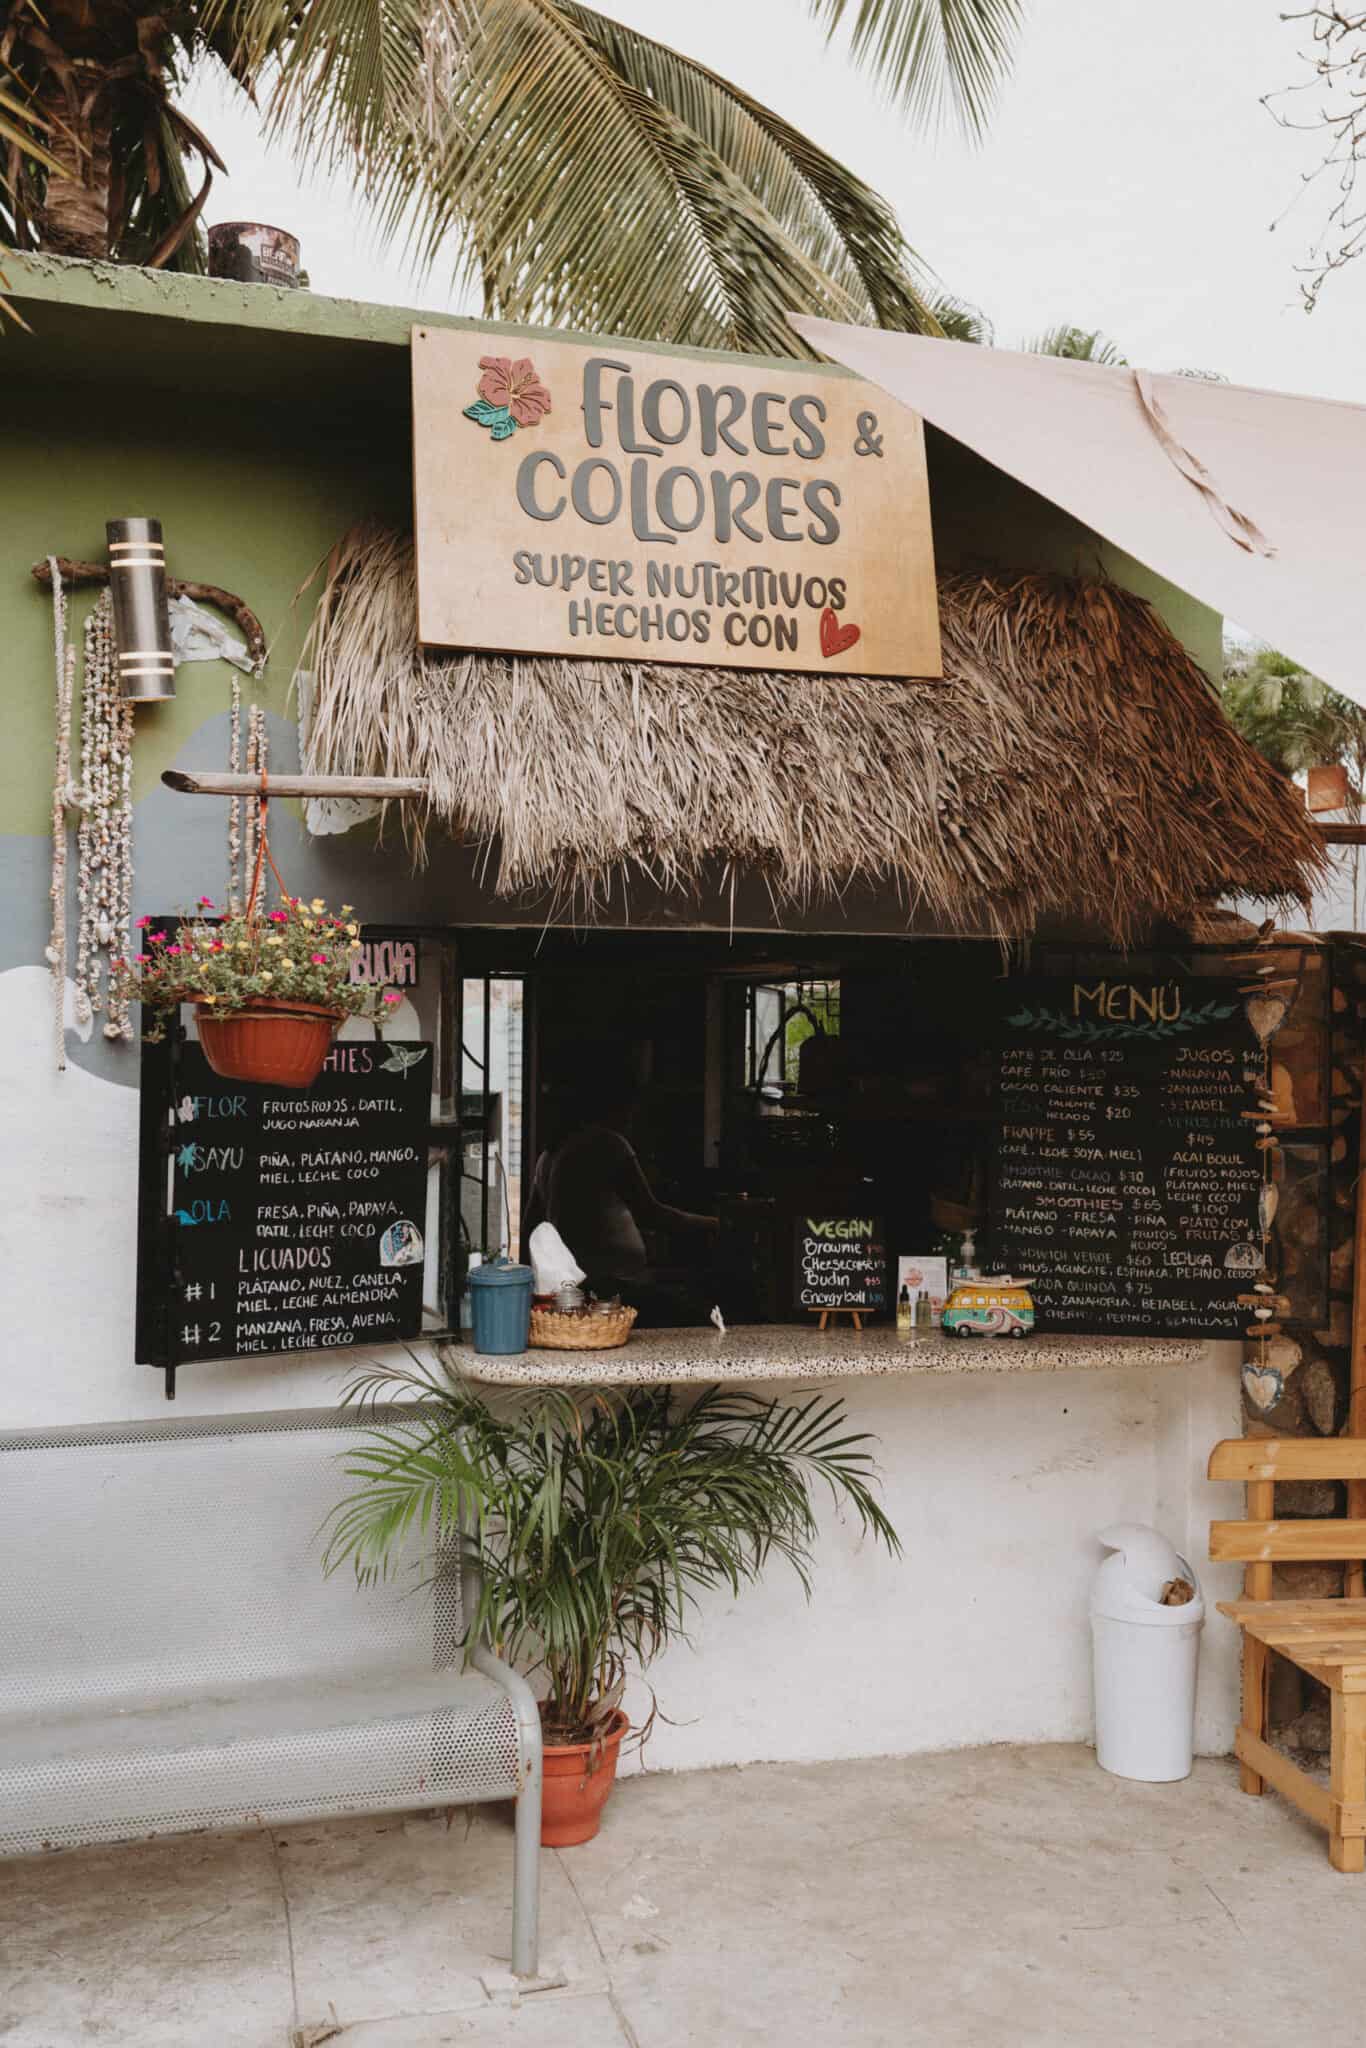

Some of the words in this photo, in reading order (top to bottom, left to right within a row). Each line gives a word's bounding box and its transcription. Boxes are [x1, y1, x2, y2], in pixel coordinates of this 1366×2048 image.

[581, 358, 826, 460] FLORES
[853, 410, 884, 459] &
[516, 451, 842, 545] COLORES
[513, 550, 633, 598] SUPER
[646, 559, 847, 611] NUTRITIVOS
[568, 597, 711, 643] HECHOS
[724, 612, 799, 652] CON
[1176, 1048, 1236, 1064] JUGOS
[1043, 1083, 1105, 1097] CALIENTE
[192, 1095, 249, 1120] FLOR
[262, 1118, 297, 1131] JUGO
[298, 1116, 361, 1129] NARANJA
[193, 1144, 245, 1173] SAYU
[1073, 1146, 1105, 1161] SOYA
[298, 1169, 341, 1184] LECHE
[347, 1166, 380, 1180] COCO
[191, 1199, 233, 1224] OLA
[1033, 1194, 1124, 1211] SMOOTHIES
[299, 1223, 336, 1239] LECHE
[340, 1223, 376, 1238] COCO
[803, 1238, 863, 1256] Brownie
[239, 1246, 332, 1273] LICUADOS
[281, 1294, 320, 1310] LECHE
[321, 1287, 400, 1307] ALMENDRA
[280, 1334, 320, 1350] LECHE
[321, 1331, 355, 1347] COCO
